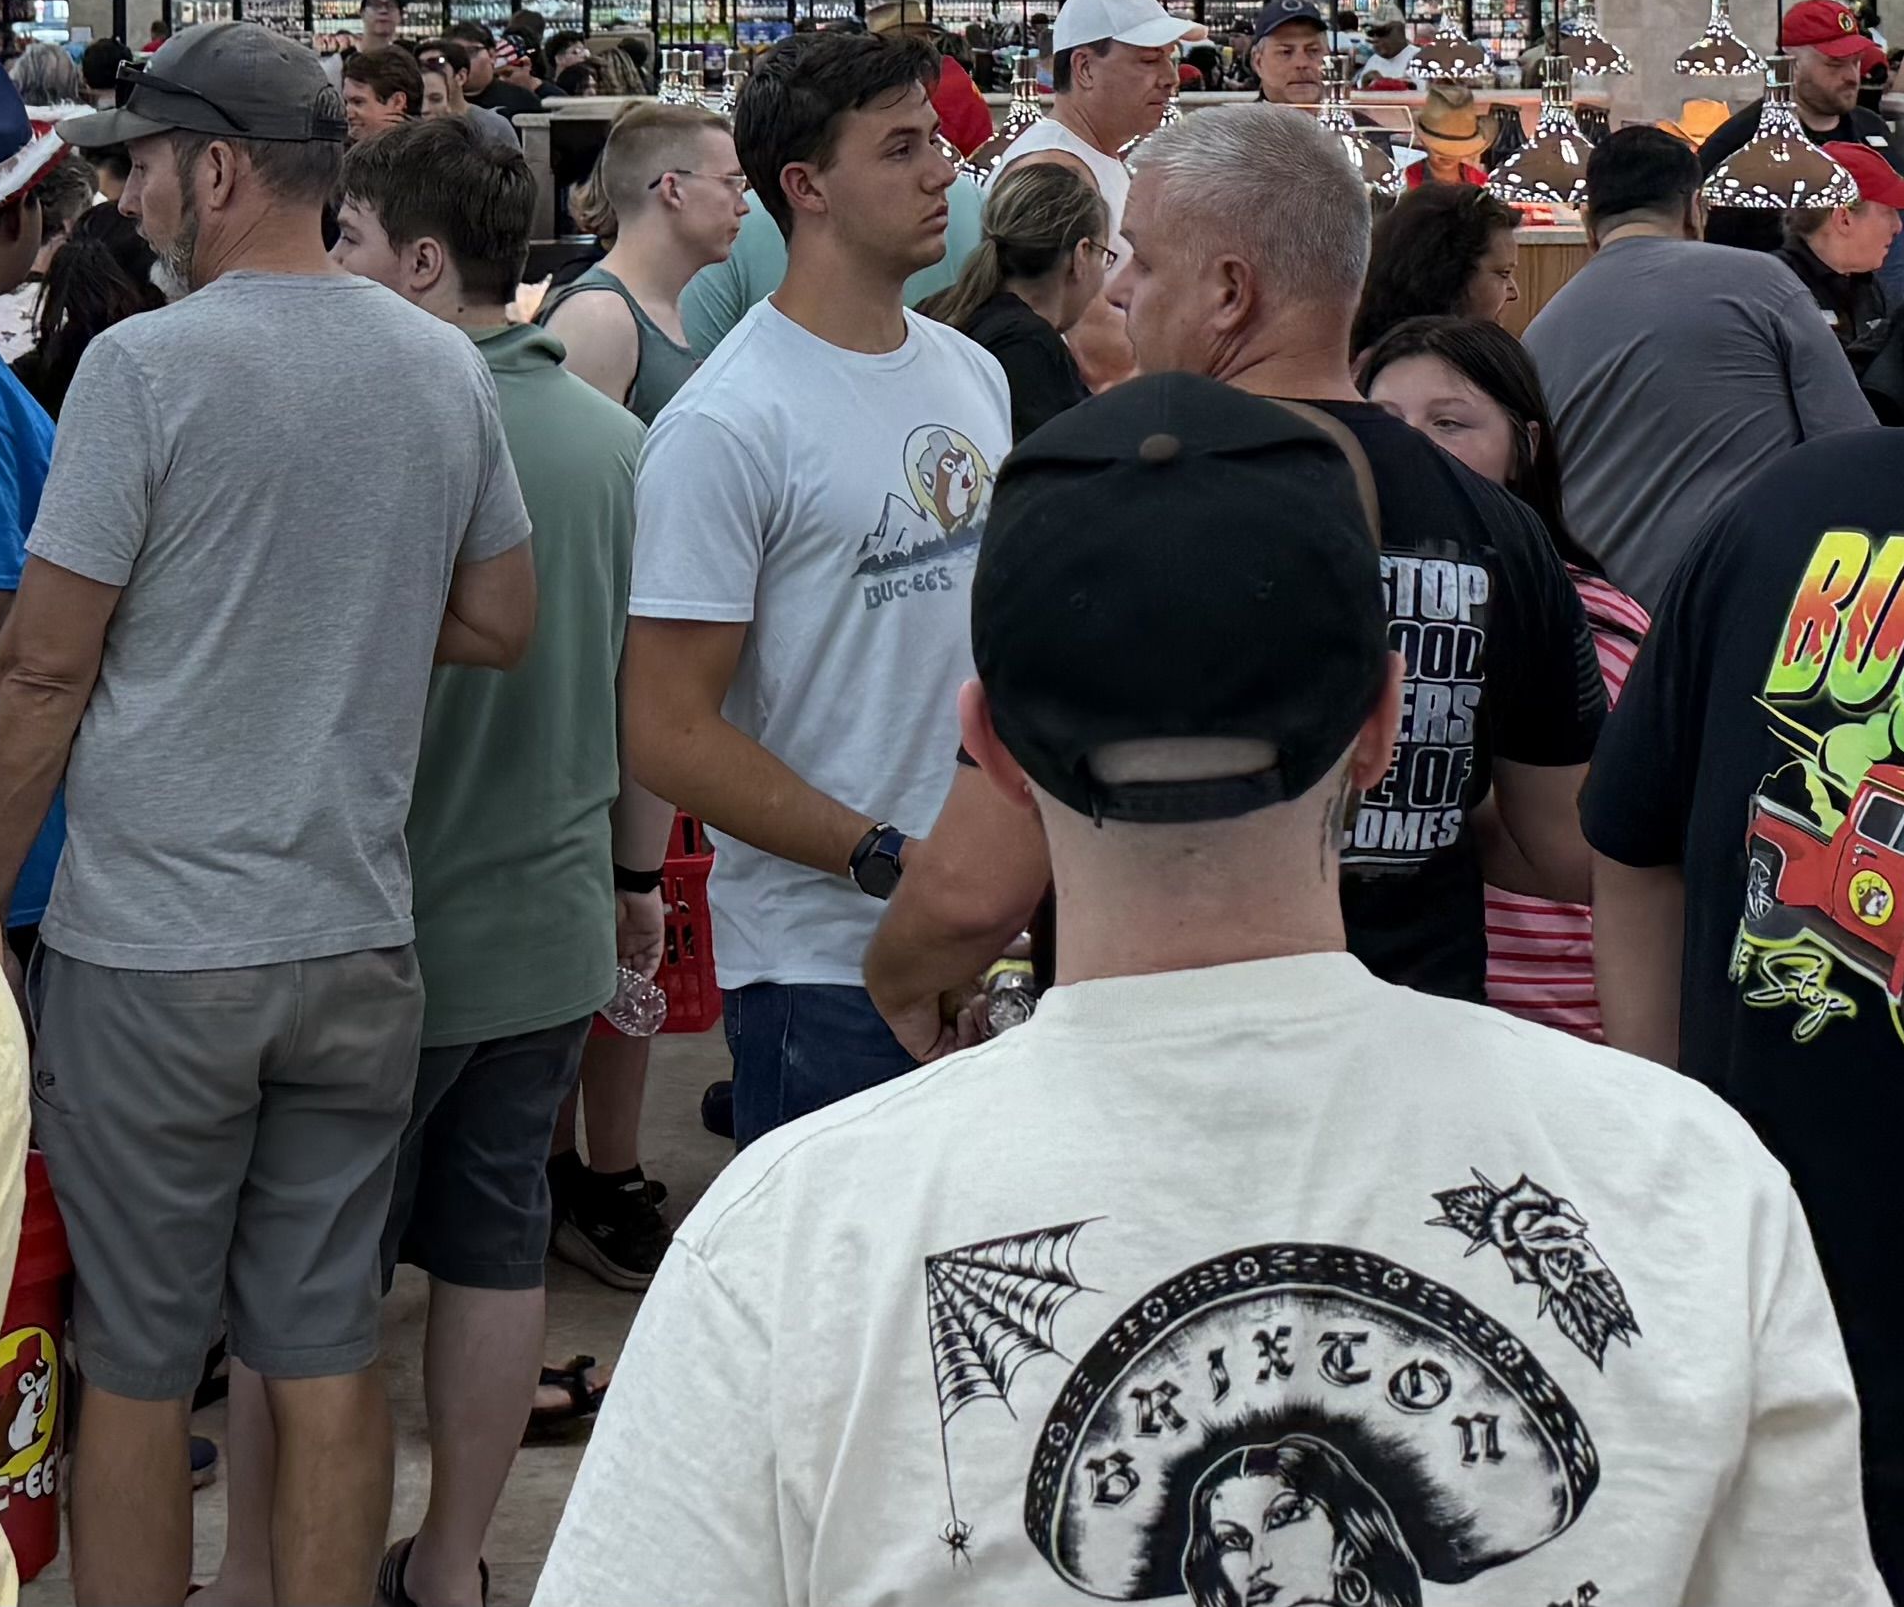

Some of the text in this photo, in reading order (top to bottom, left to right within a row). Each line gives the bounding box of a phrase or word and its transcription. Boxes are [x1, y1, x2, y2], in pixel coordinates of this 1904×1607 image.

[863, 565, 954, 611] BUC-EE'S
[1407, 745, 1474, 810] OF
[1744, 950, 1854, 1042] Stop
[1083, 1325, 1508, 1508] BRIXTON
